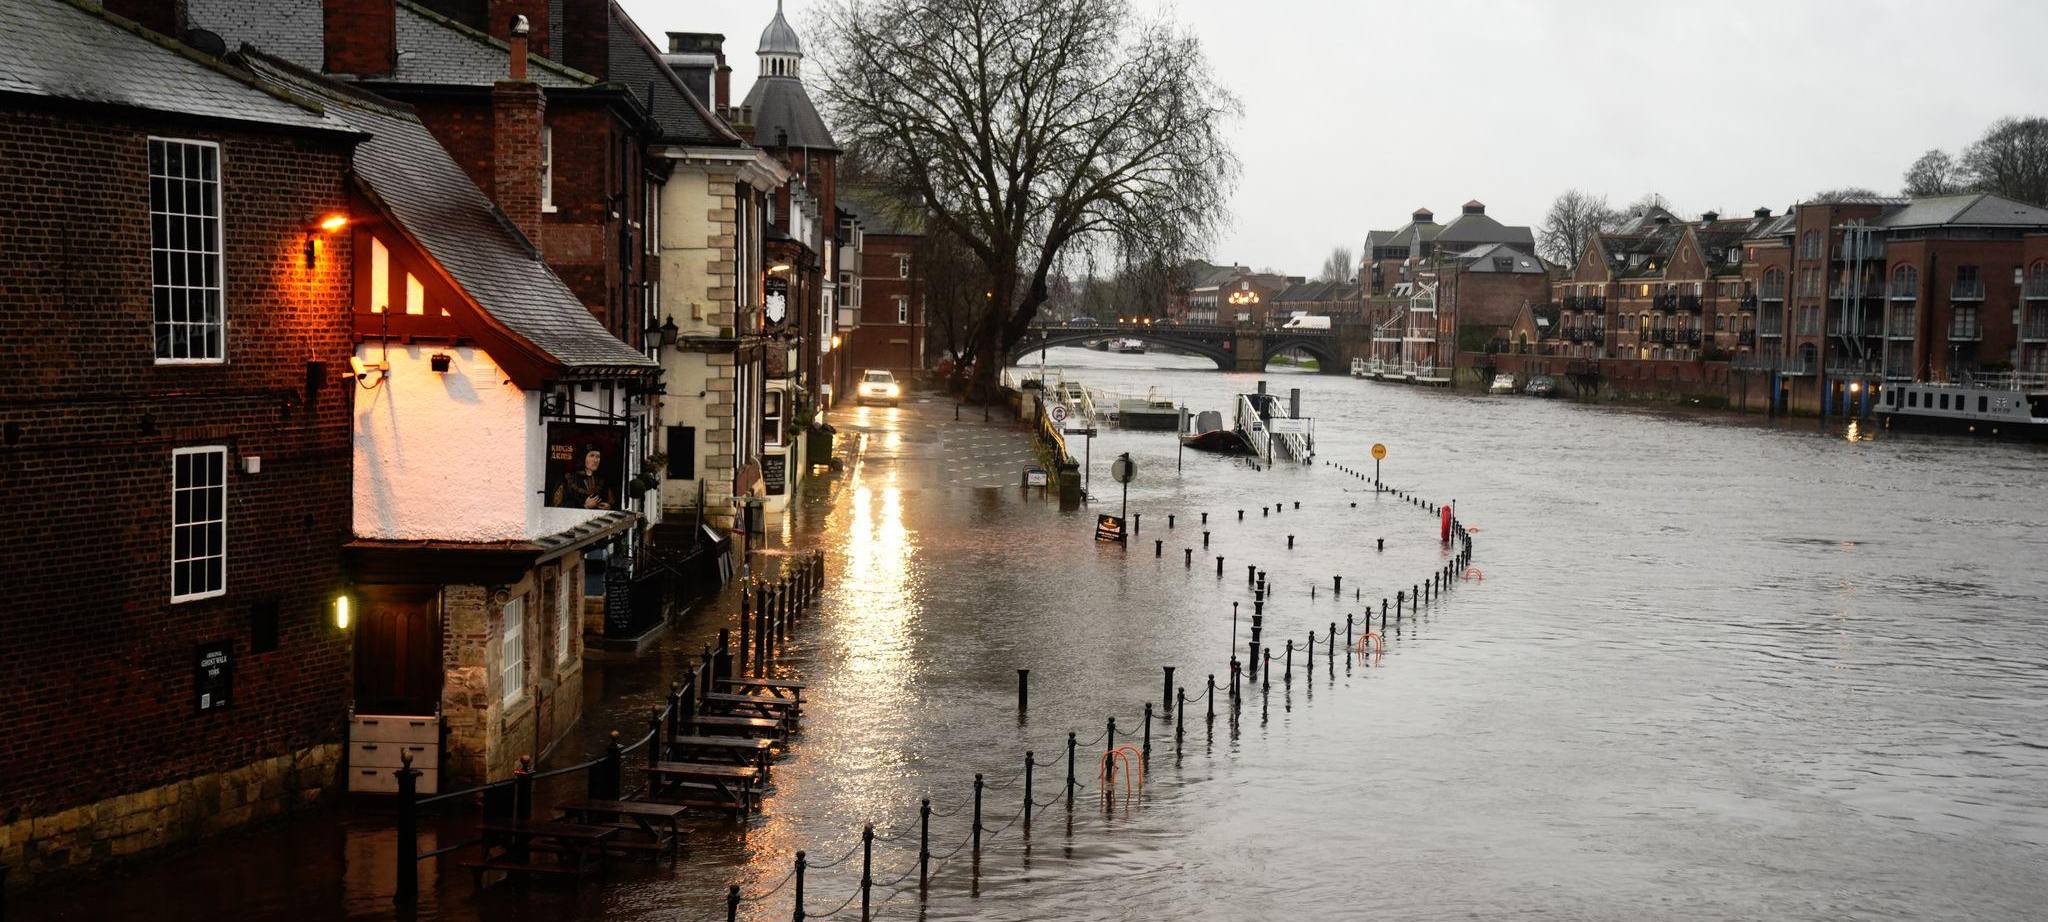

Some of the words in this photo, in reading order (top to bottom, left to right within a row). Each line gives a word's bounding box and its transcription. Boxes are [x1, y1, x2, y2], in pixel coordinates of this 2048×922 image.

[551, 452, 573, 460] ARMS
[201, 658, 216, 667] GHOST
[216, 655, 227, 664] WALK
[208, 668, 220, 677] YORK
